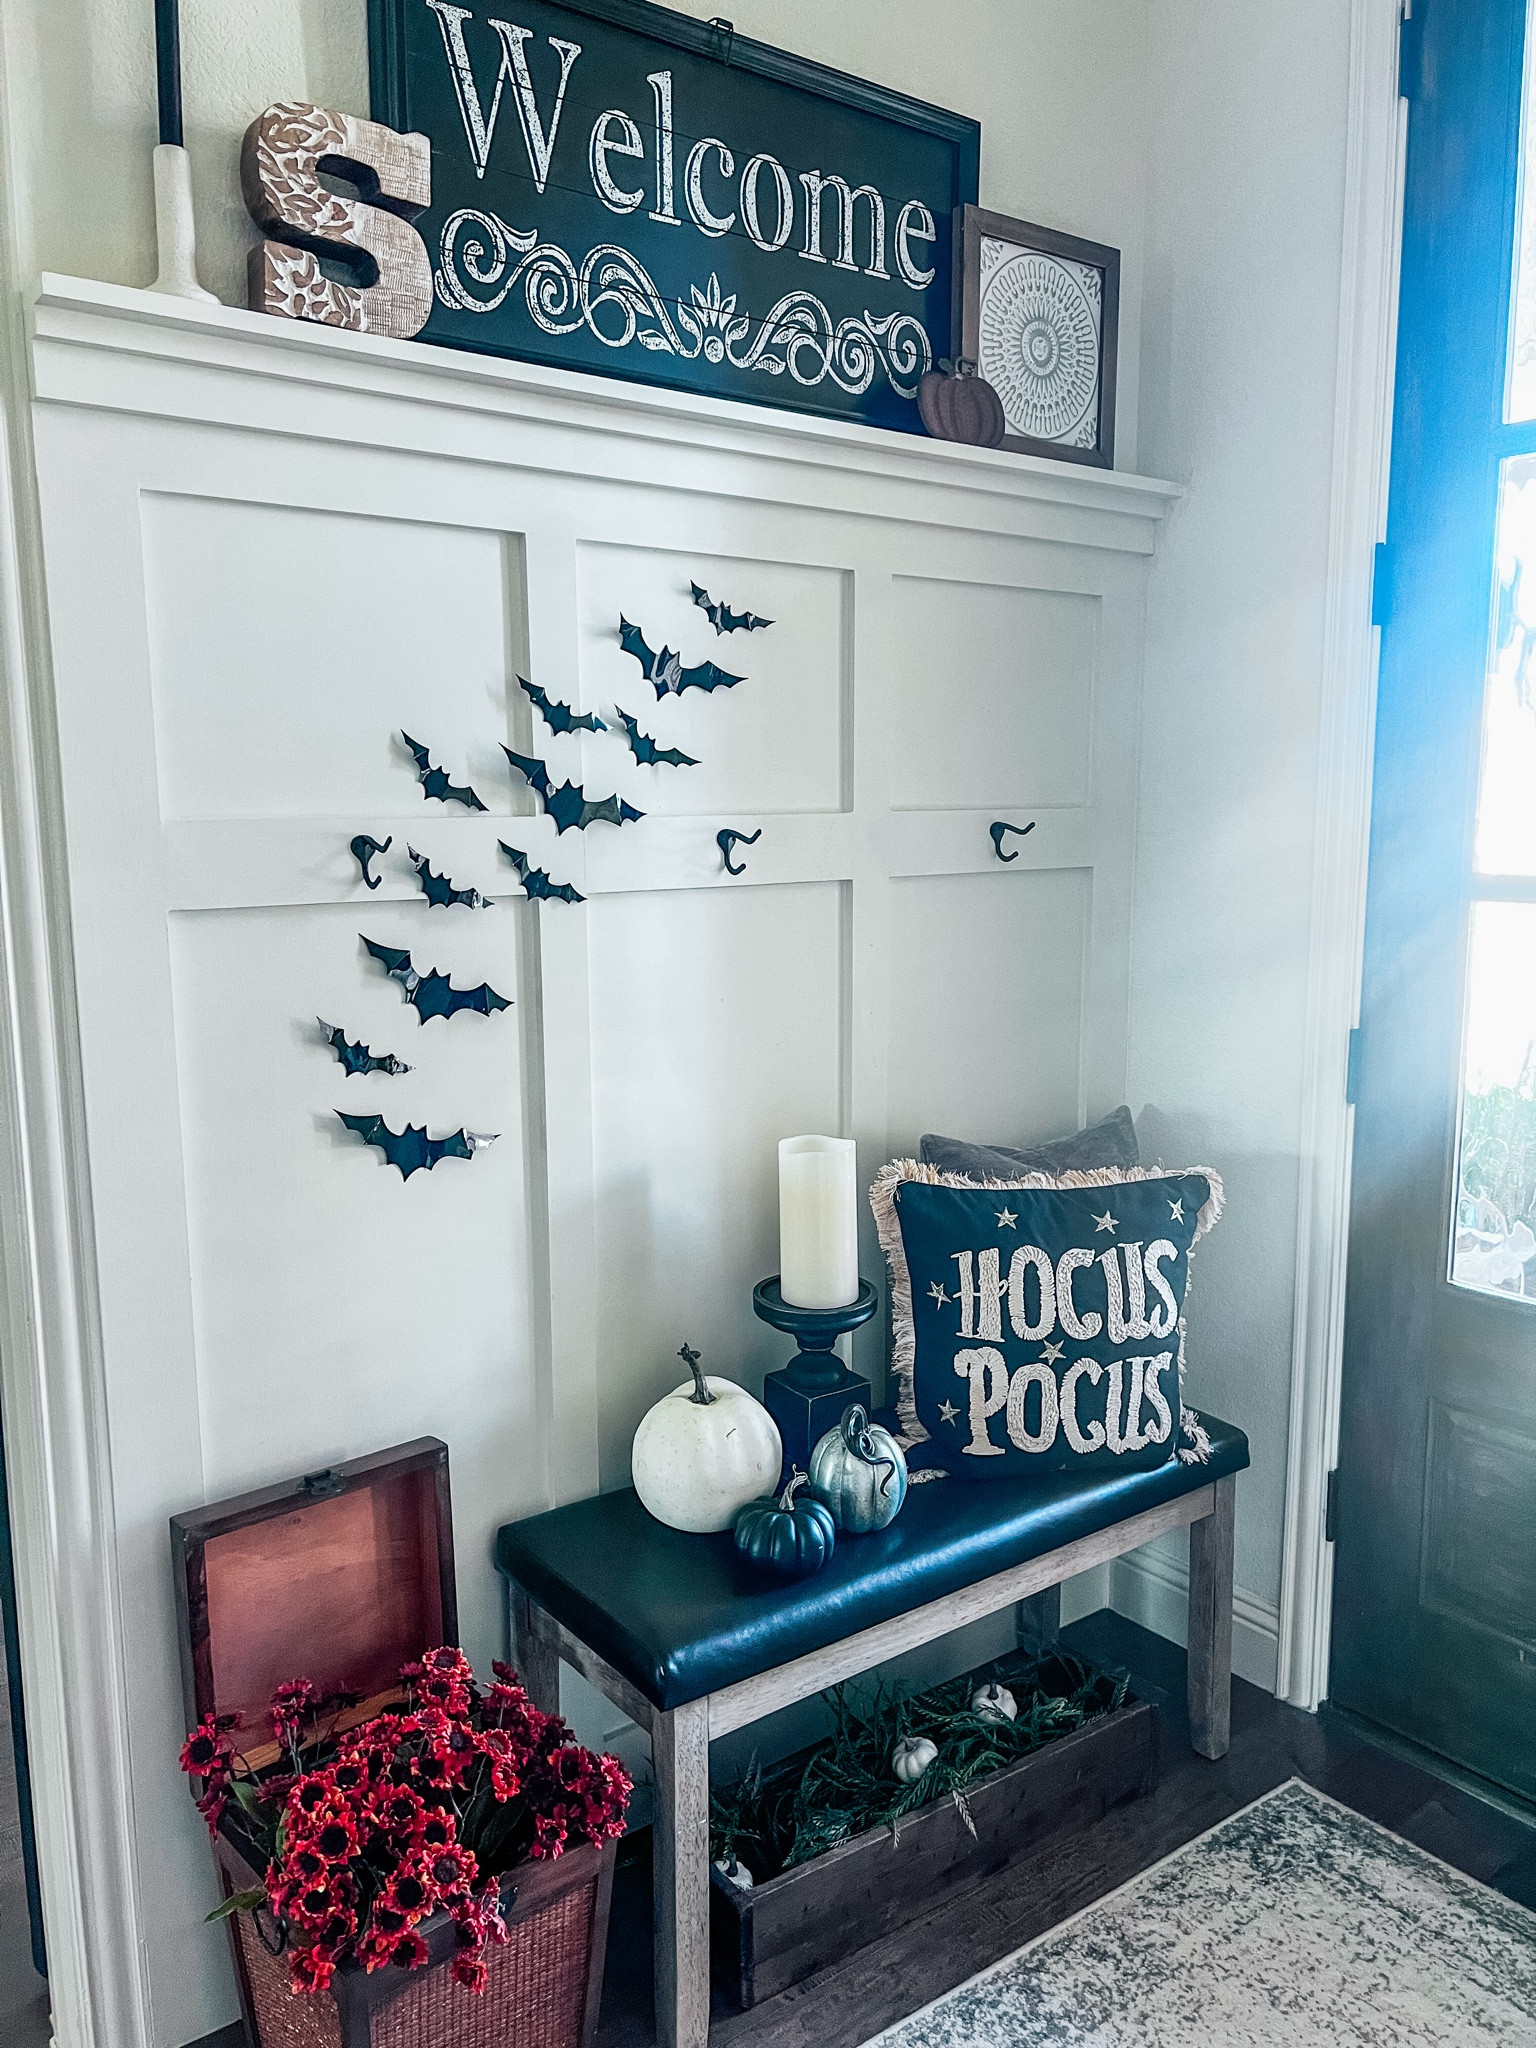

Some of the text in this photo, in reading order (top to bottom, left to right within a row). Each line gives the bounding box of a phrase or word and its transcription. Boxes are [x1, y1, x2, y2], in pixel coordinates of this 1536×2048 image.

[241, 102, 434, 339] S
[426, 0, 938, 290] Welcome
[951, 1239, 1178, 1344] HOCUS
[954, 1346, 1173, 1456] POCUS
